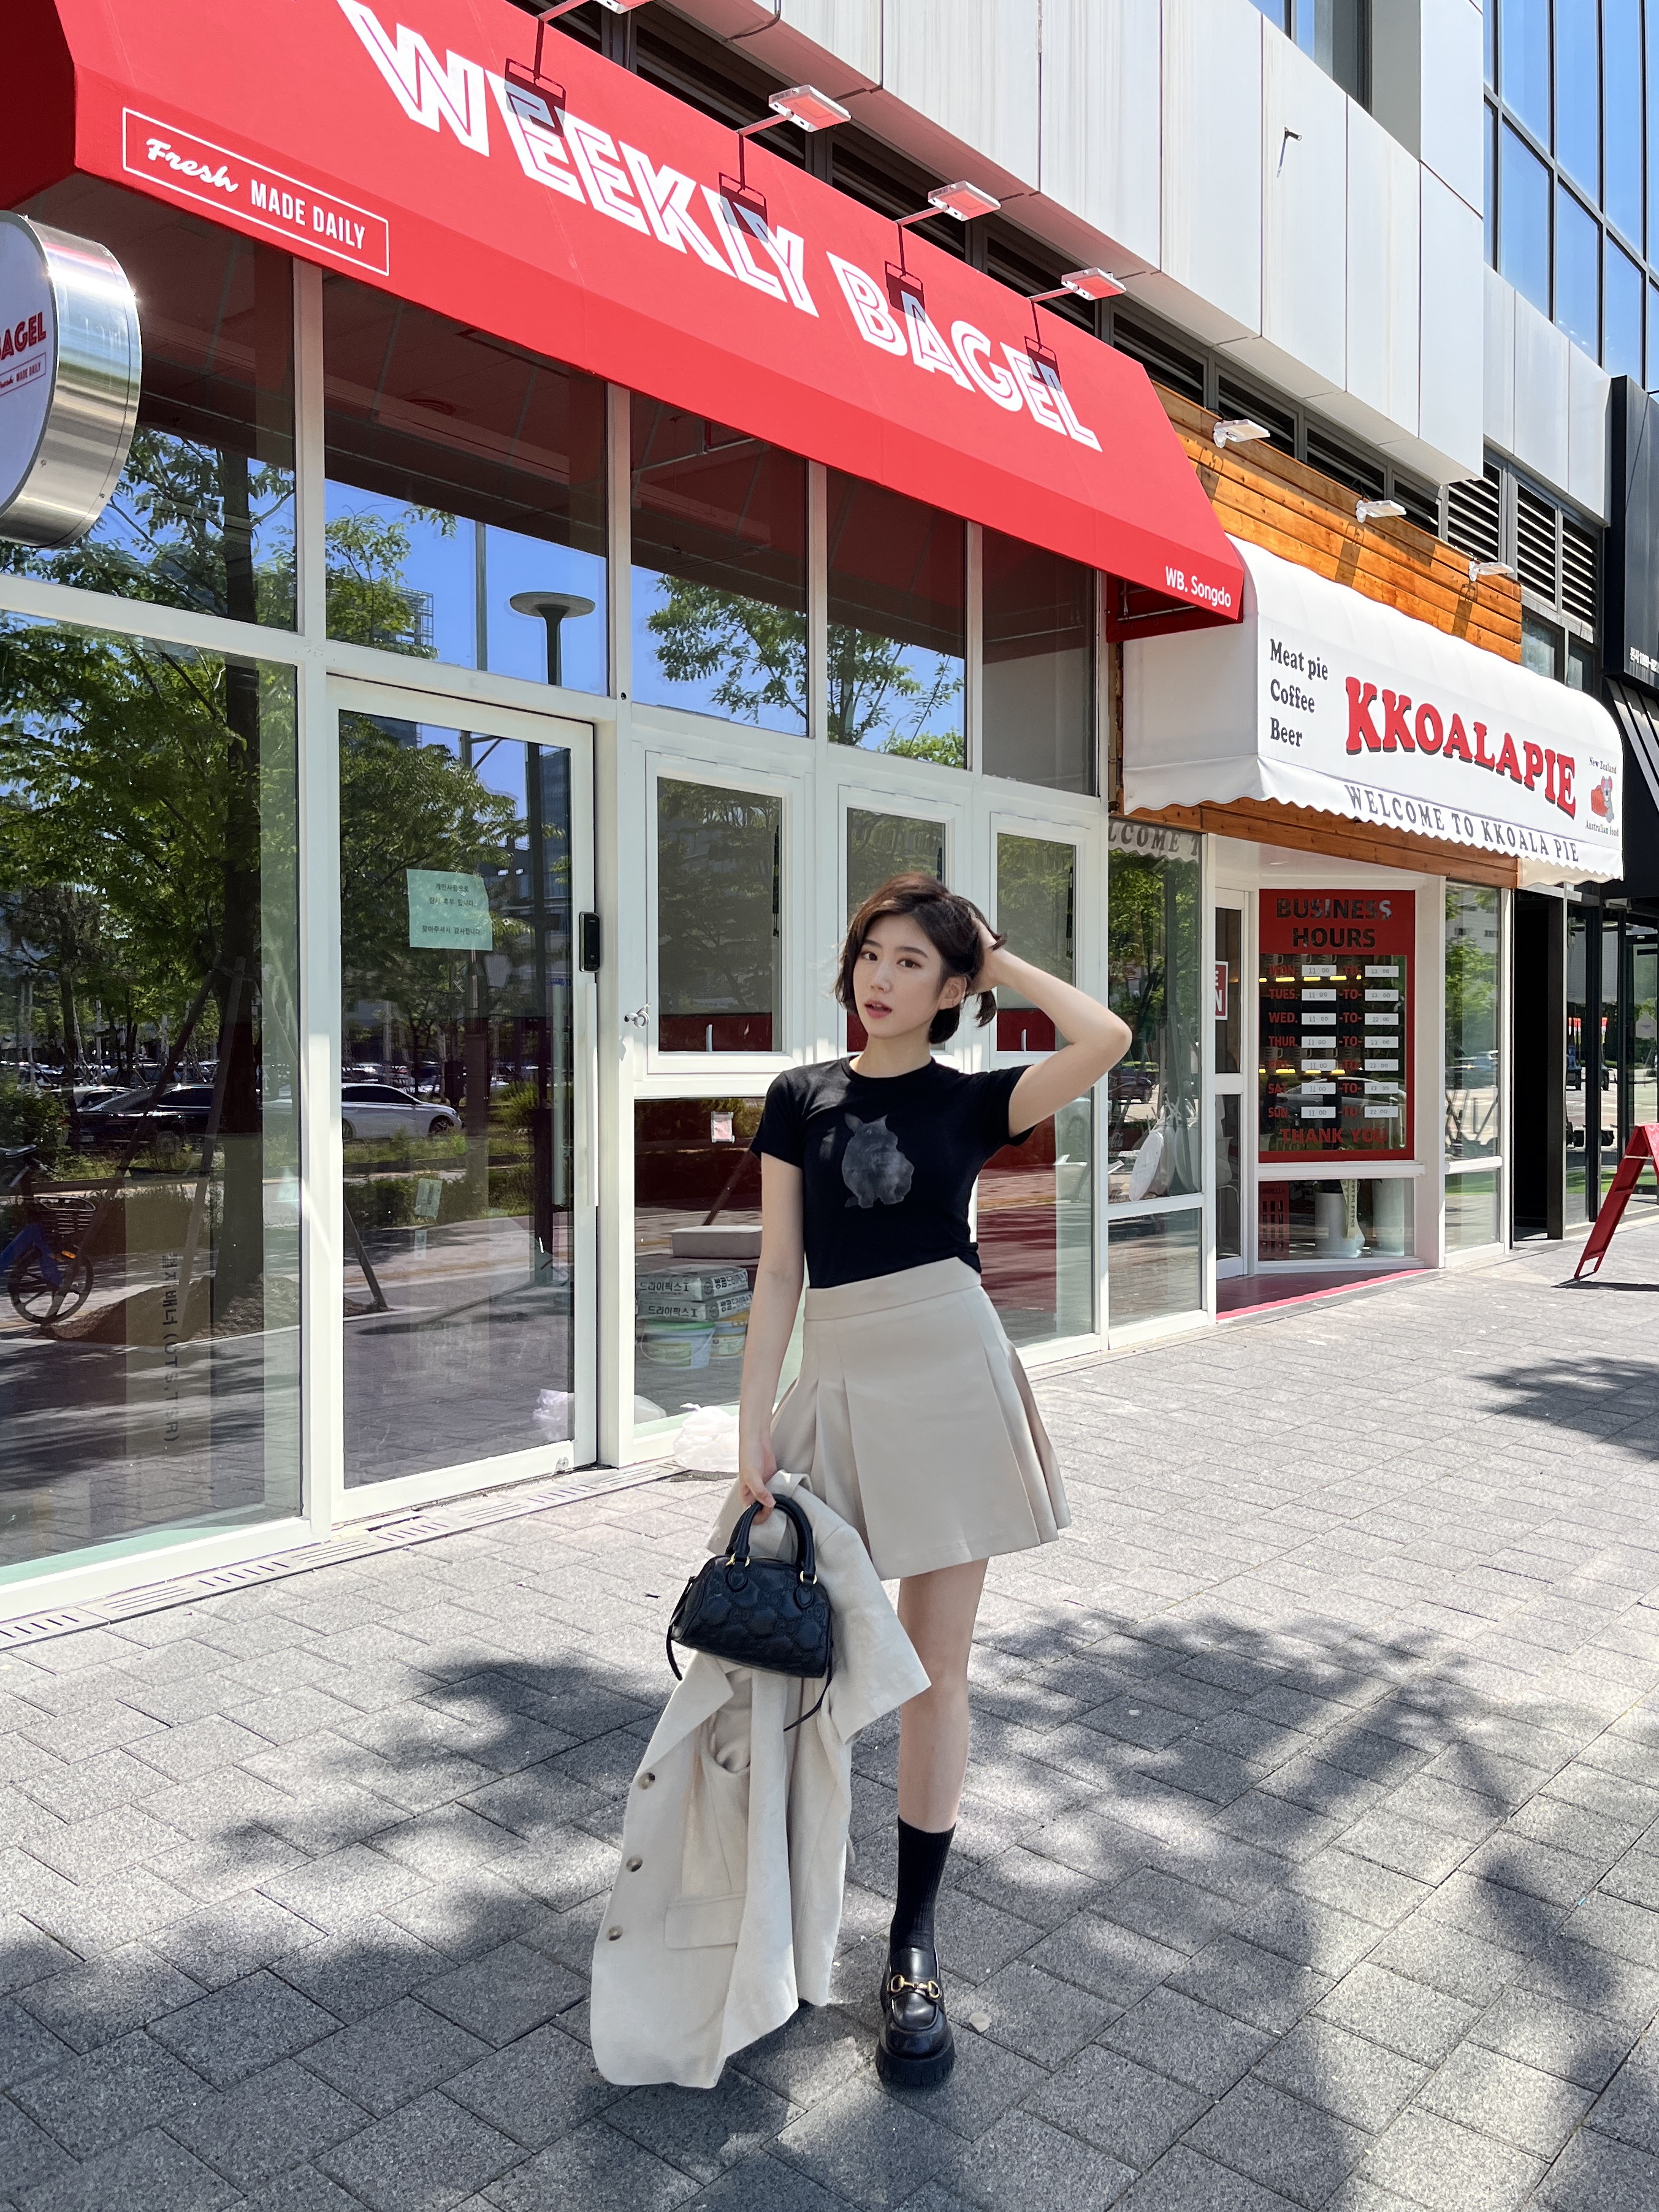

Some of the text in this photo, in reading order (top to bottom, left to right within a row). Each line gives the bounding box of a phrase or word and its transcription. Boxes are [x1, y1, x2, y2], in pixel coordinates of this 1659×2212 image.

[147, 138, 365, 250] Fresh MADE DAILY
[338, 0, 1103, 452] WEEKLY BAGEL
[0, 311, 47, 360] AGEL
[1165, 565, 1232, 608] WB. Songdo
[1270, 638, 1329, 681] Meat pie
[1270, 678, 1315, 713] Coffee
[1270, 717, 1303, 747] Beer
[1344, 676, 1578, 820] KKOALAPIE
[1588, 756, 1617, 774] New Zealand
[1344, 784, 1580, 862] WELCOME TO KKOALA PIE
[1585, 820, 1609, 834] Australian
[1276, 898, 1392, 920] BUSINESS
[1292, 926, 1376, 948] HOURS
[1268, 988, 1299, 1000] TUES.
[1268, 1012, 1298, 1023] WED.
[1268, 1035, 1299, 1047] THUR.
[1280, 1127, 1389, 1144] THANK YOU
